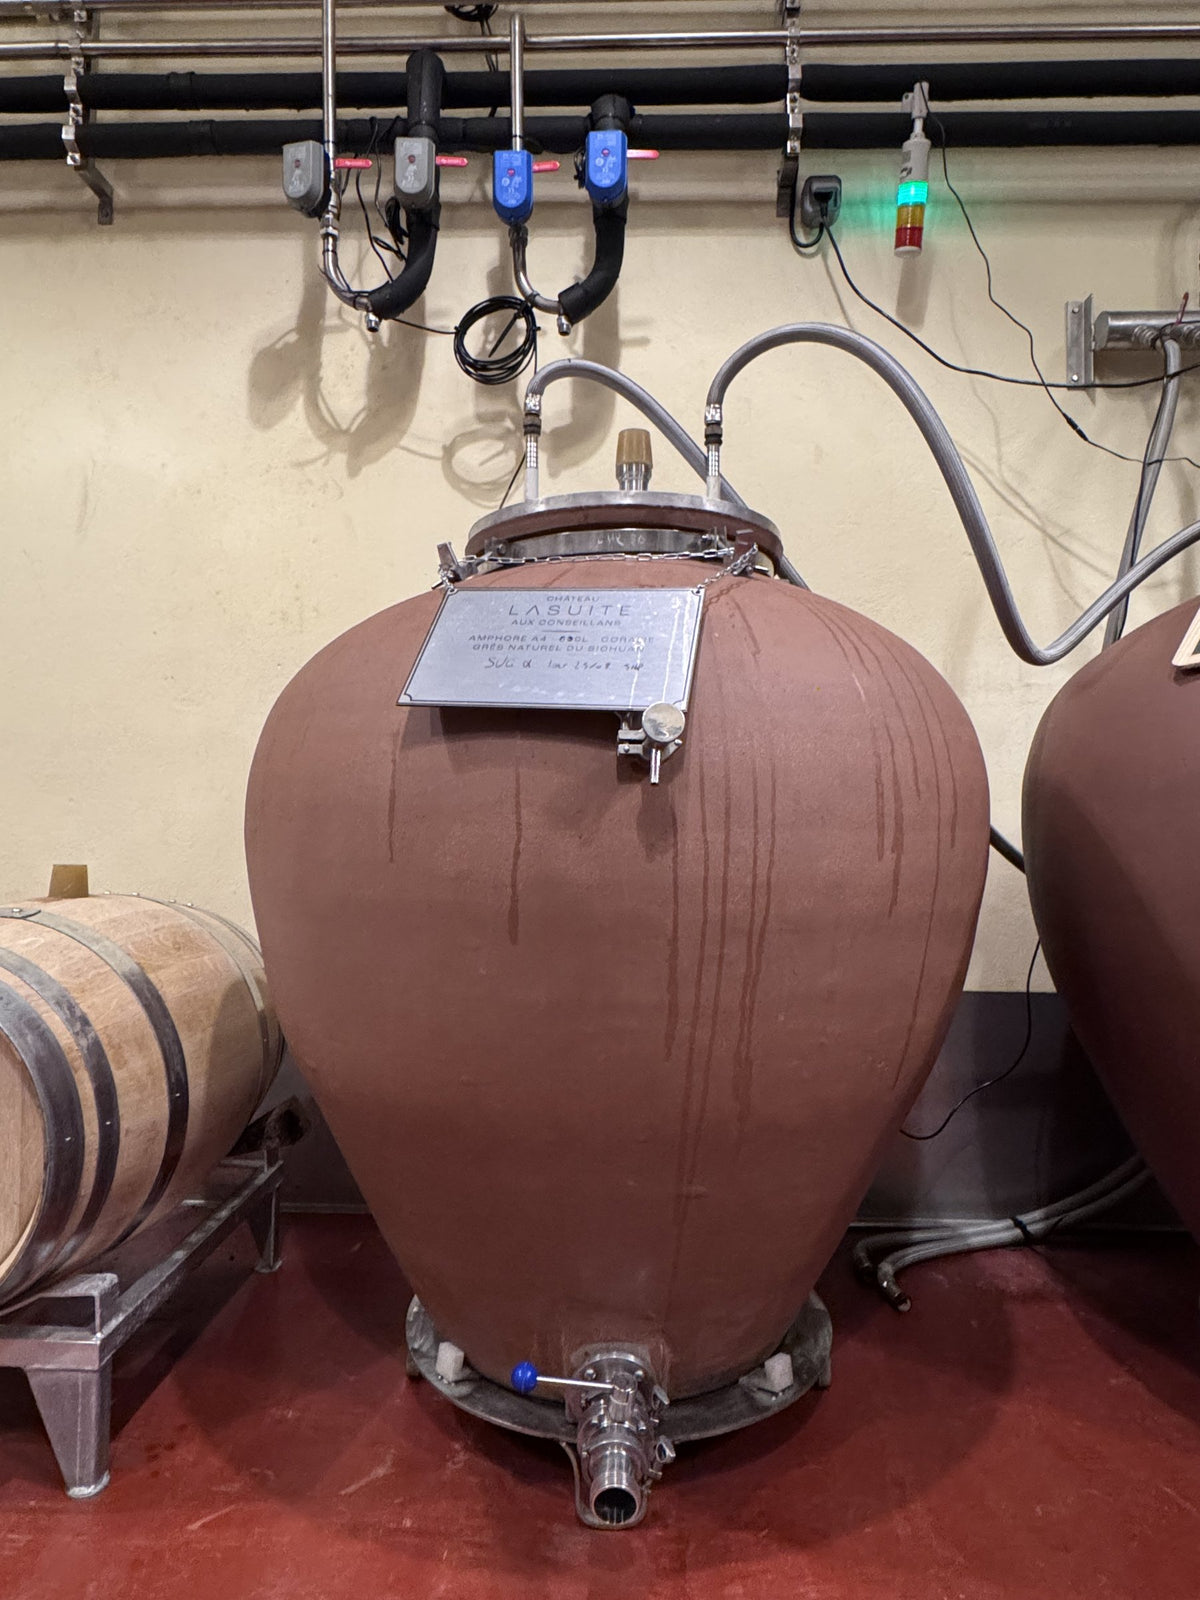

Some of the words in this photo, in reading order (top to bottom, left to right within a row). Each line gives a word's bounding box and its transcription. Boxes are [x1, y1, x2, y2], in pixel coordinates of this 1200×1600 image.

[511, 619, 535, 627] AUX
[468, 634, 528, 642] AMPHORE
[507, 643, 561, 652] NATUREL
[566, 644, 584, 653] DU
